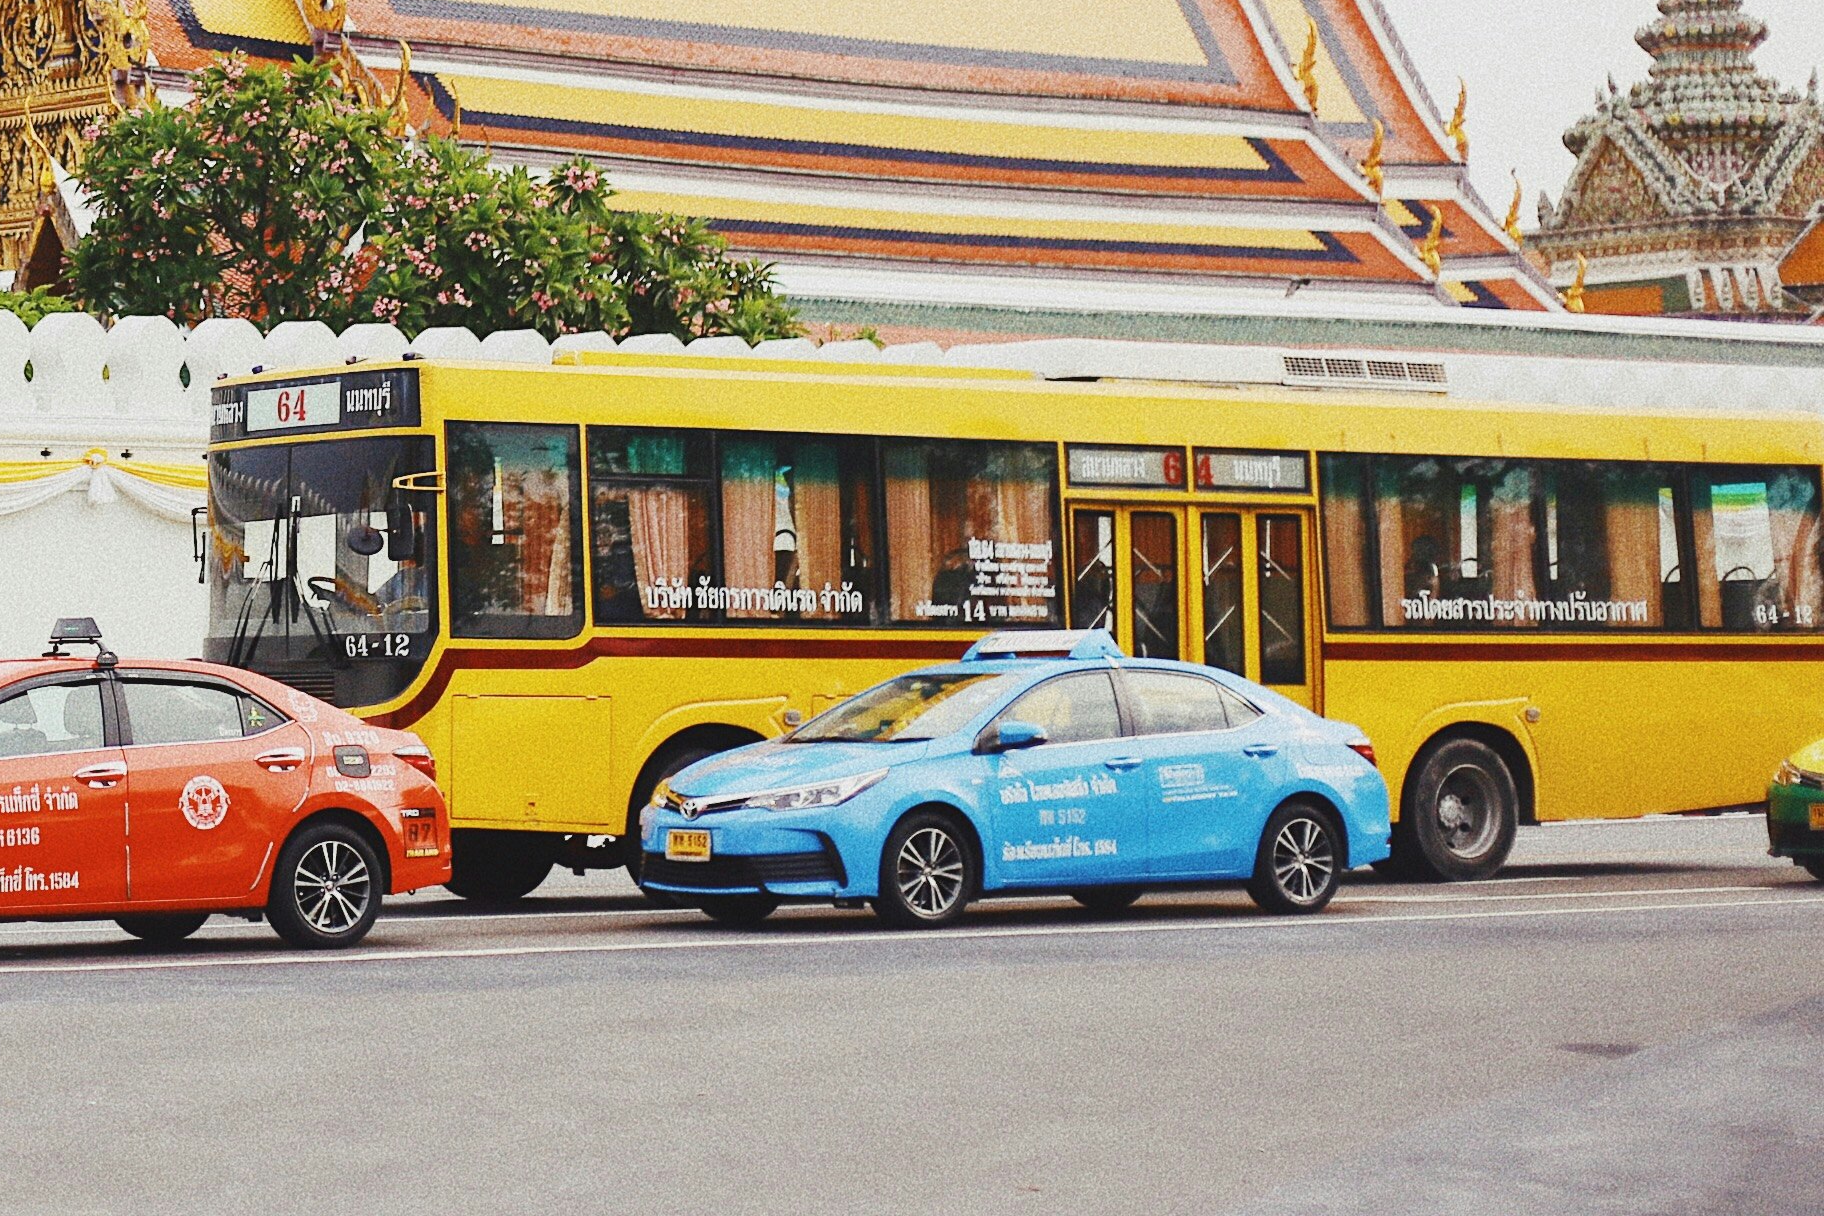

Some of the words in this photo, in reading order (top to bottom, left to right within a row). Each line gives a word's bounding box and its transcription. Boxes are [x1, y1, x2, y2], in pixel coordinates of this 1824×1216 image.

[277, 389, 306, 422] 64
[346, 381, 391, 417] นนทบุรี
[645, 576, 693, 609] บริษัท
[819, 581, 863, 613] จำกัด
[1401, 589, 1648, 622] รถโดยสารประจำทางปรับอากาศ
[962, 600, 986, 622] 14
[345, 633, 410, 657] 64-12
[44, 785, 79, 811] จำกัด
